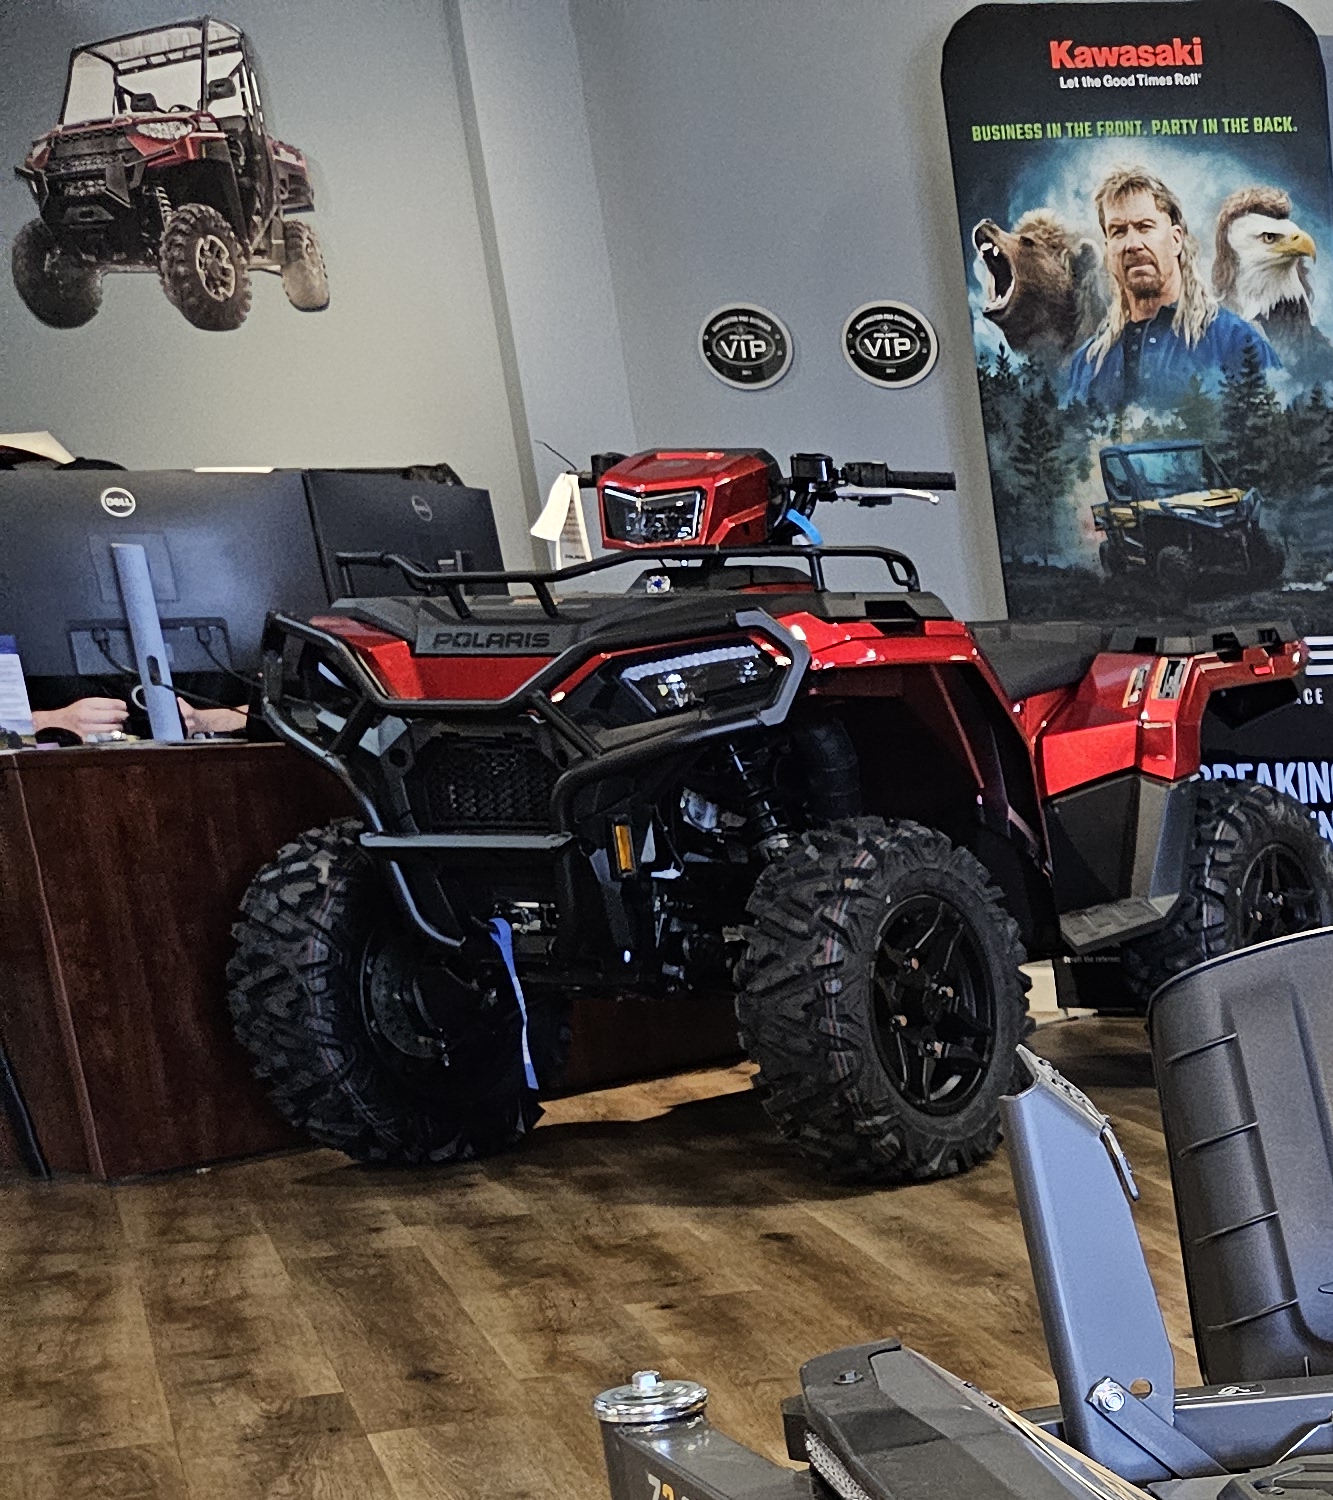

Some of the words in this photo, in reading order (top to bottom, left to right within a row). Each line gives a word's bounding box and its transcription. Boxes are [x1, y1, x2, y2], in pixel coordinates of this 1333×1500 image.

[1050, 37, 1203, 69] Kawasaki
[1059, 76, 1080, 89] Let
[1081, 75, 1101, 88] the
[1102, 74, 1136, 87] Good
[1136, 73, 1173, 87] Times
[971, 123, 1043, 142] BUSINESS
[1046, 122, 1062, 139] IN
[1065, 121, 1093, 138] THE
[1096, 120, 1148, 138] FRONT.
[1151, 119, 1198, 136] PARTY
[1202, 118, 1218, 135] IN
[1222, 117, 1250, 134] THE
[1253, 116, 1298, 133] BACK.
[720, 340, 767, 359] VIP
[864, 338, 911, 357] VIP
[432, 632, 550, 649] POLARIS
